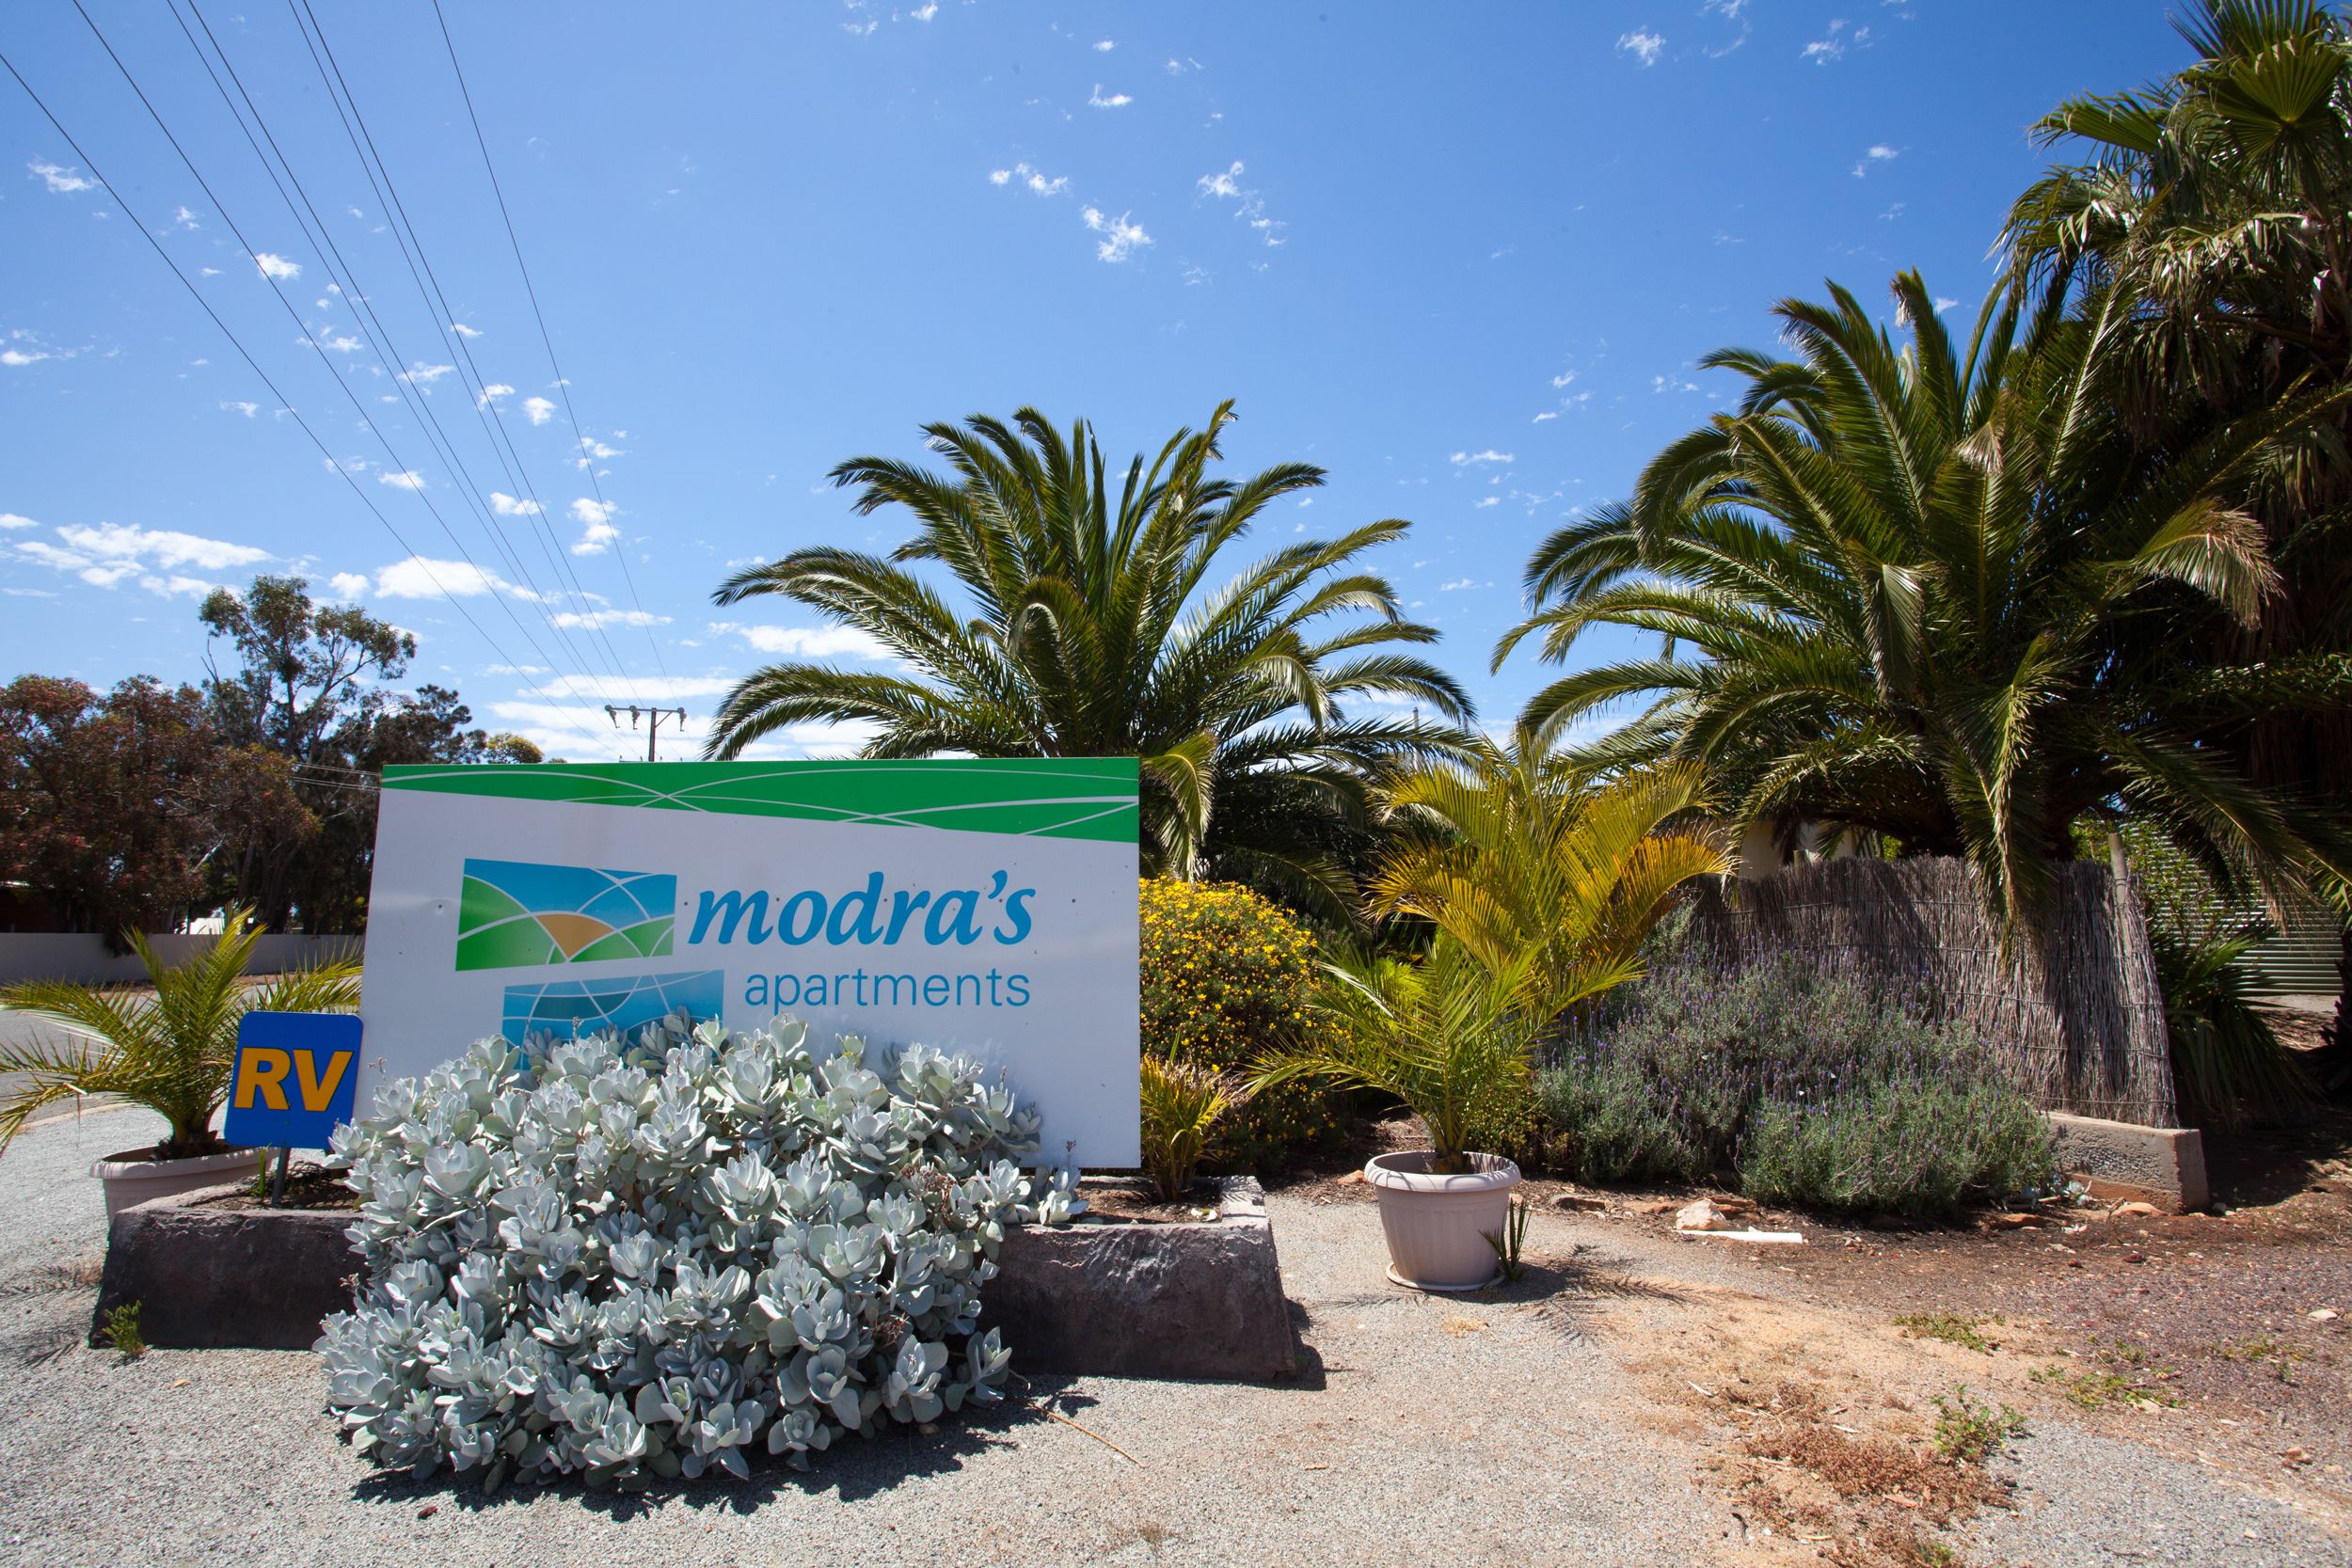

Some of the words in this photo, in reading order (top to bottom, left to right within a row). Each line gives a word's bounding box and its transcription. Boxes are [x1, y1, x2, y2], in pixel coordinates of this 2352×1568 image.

[688, 869, 1036, 946] modra's
[744, 968, 1030, 1016] apartments
[234, 1047, 354, 1111] RV
